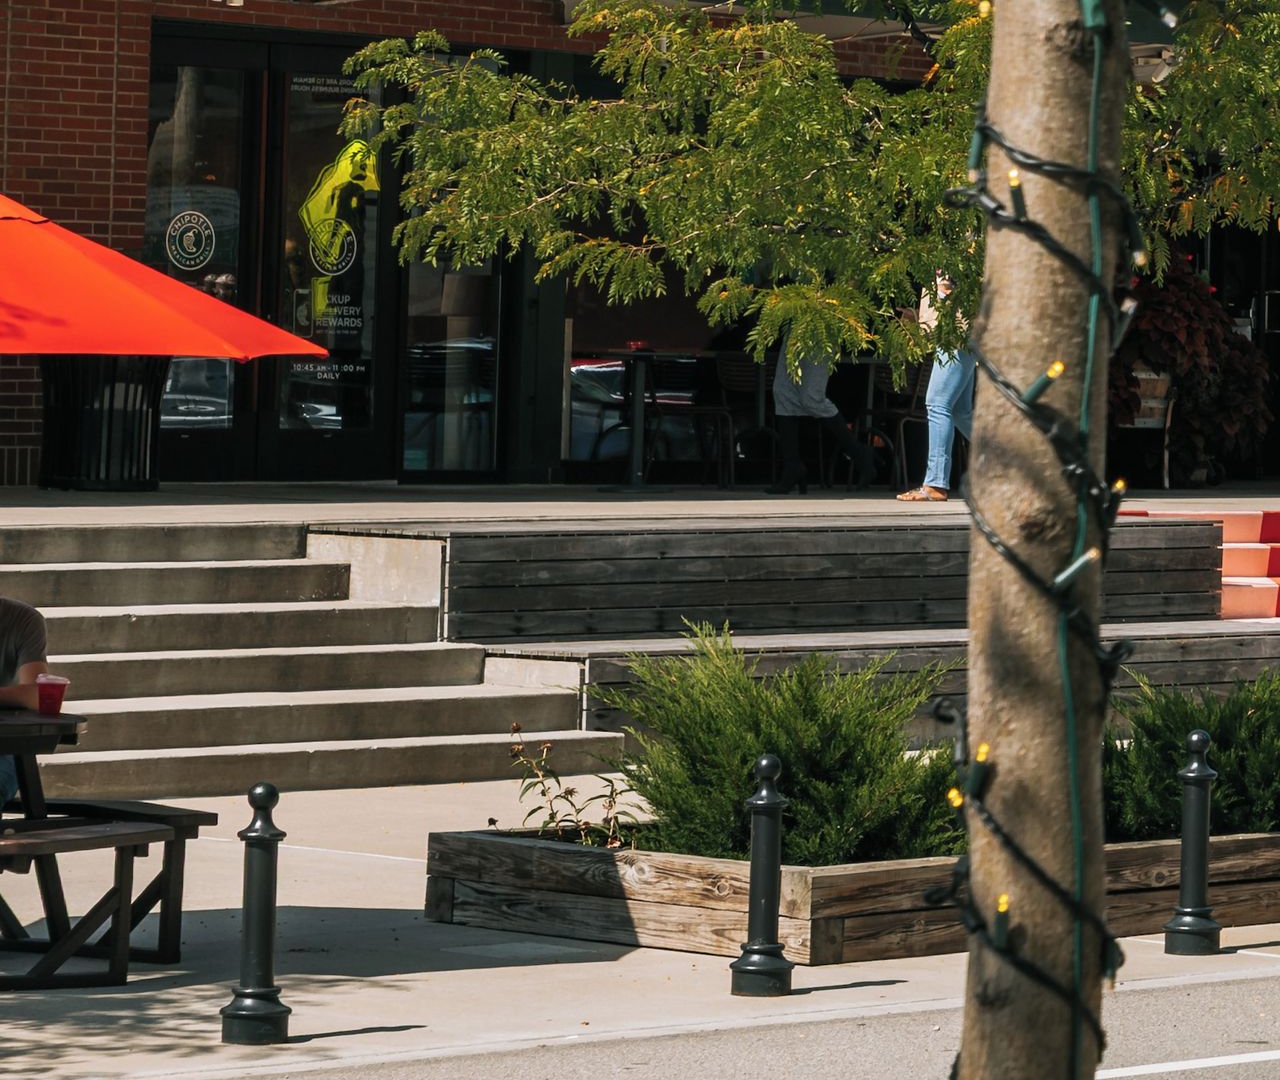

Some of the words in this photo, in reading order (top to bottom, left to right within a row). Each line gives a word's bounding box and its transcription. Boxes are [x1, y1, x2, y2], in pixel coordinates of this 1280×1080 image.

[171, 215, 211, 237] CHIPOTLE
[293, 364, 314, 372] 10:45
[317, 372, 340, 380] DAILY
